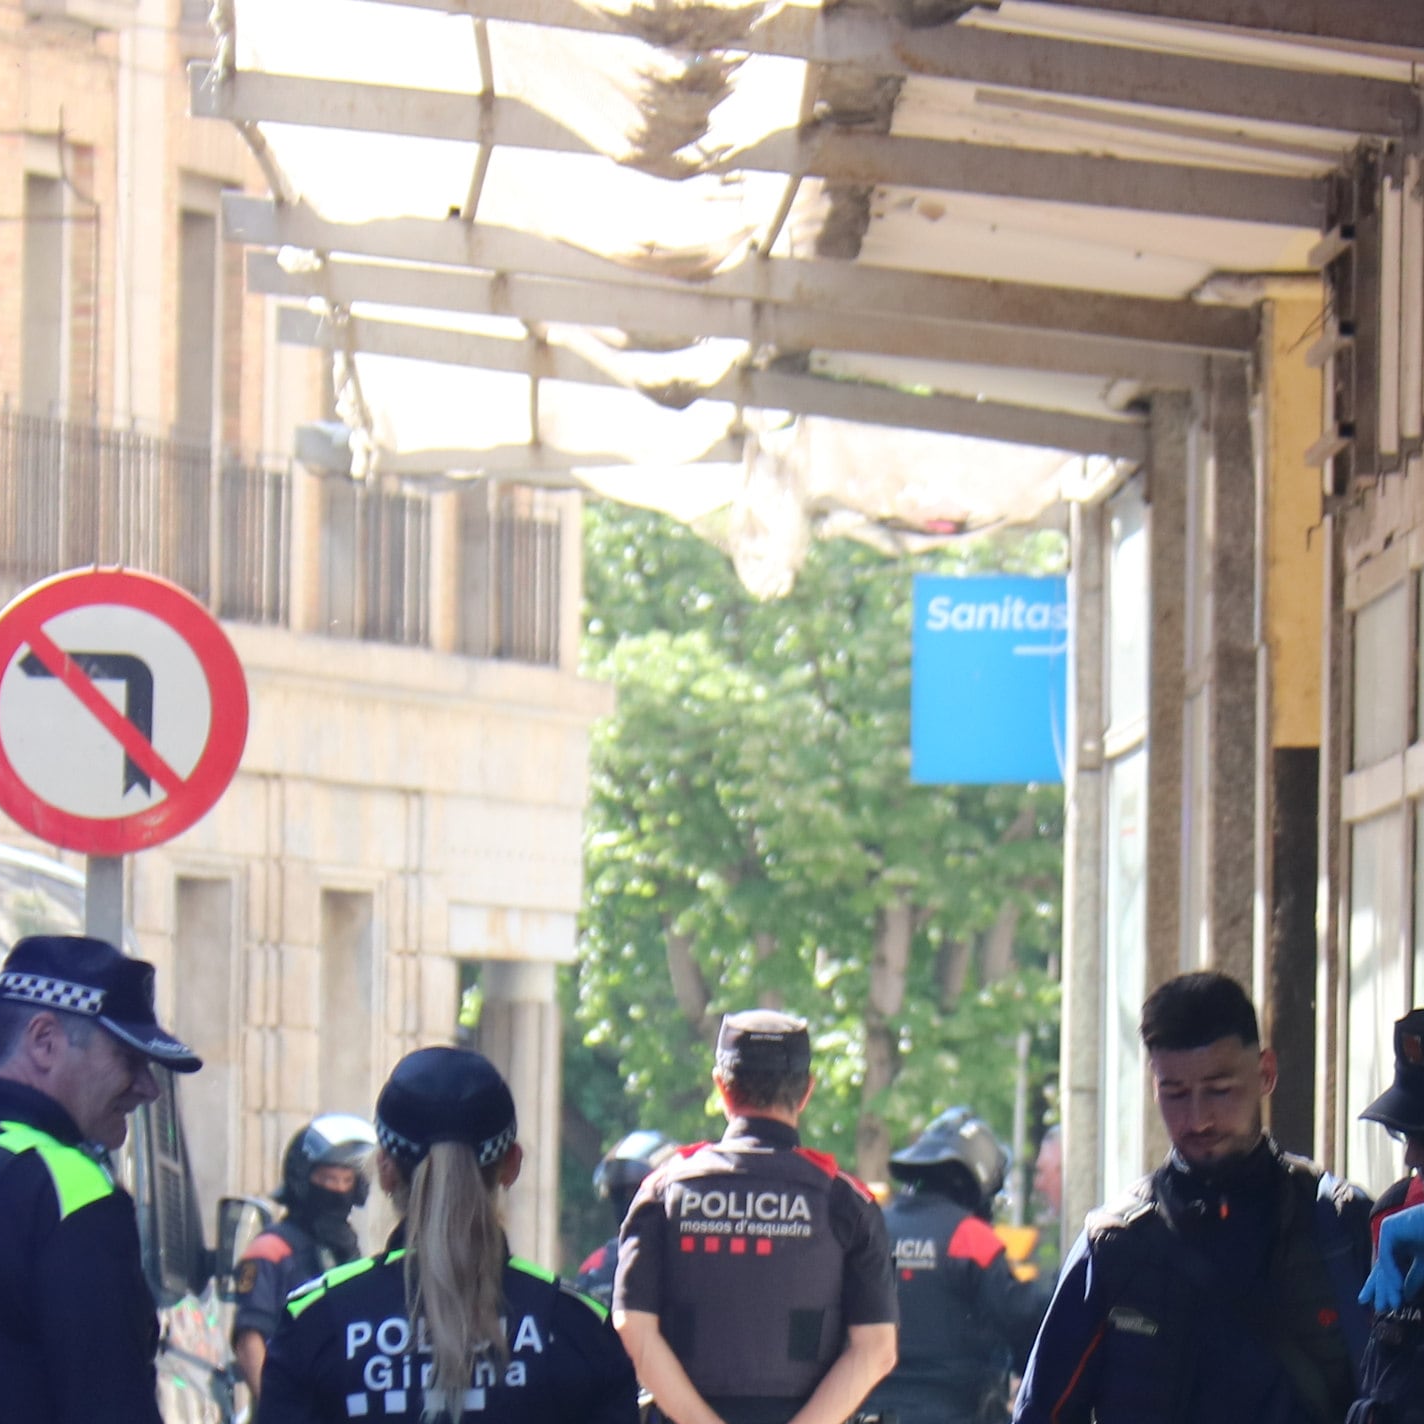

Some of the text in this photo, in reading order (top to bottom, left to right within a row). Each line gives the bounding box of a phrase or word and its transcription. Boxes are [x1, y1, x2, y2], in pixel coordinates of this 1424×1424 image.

[925, 594, 1069, 632] Sanitas
[679, 1190, 812, 1221] POLICIA
[679, 1219, 732, 1236] mossos
[345, 1314, 544, 1361] POLIA
[363, 1354, 528, 1391] Girna
